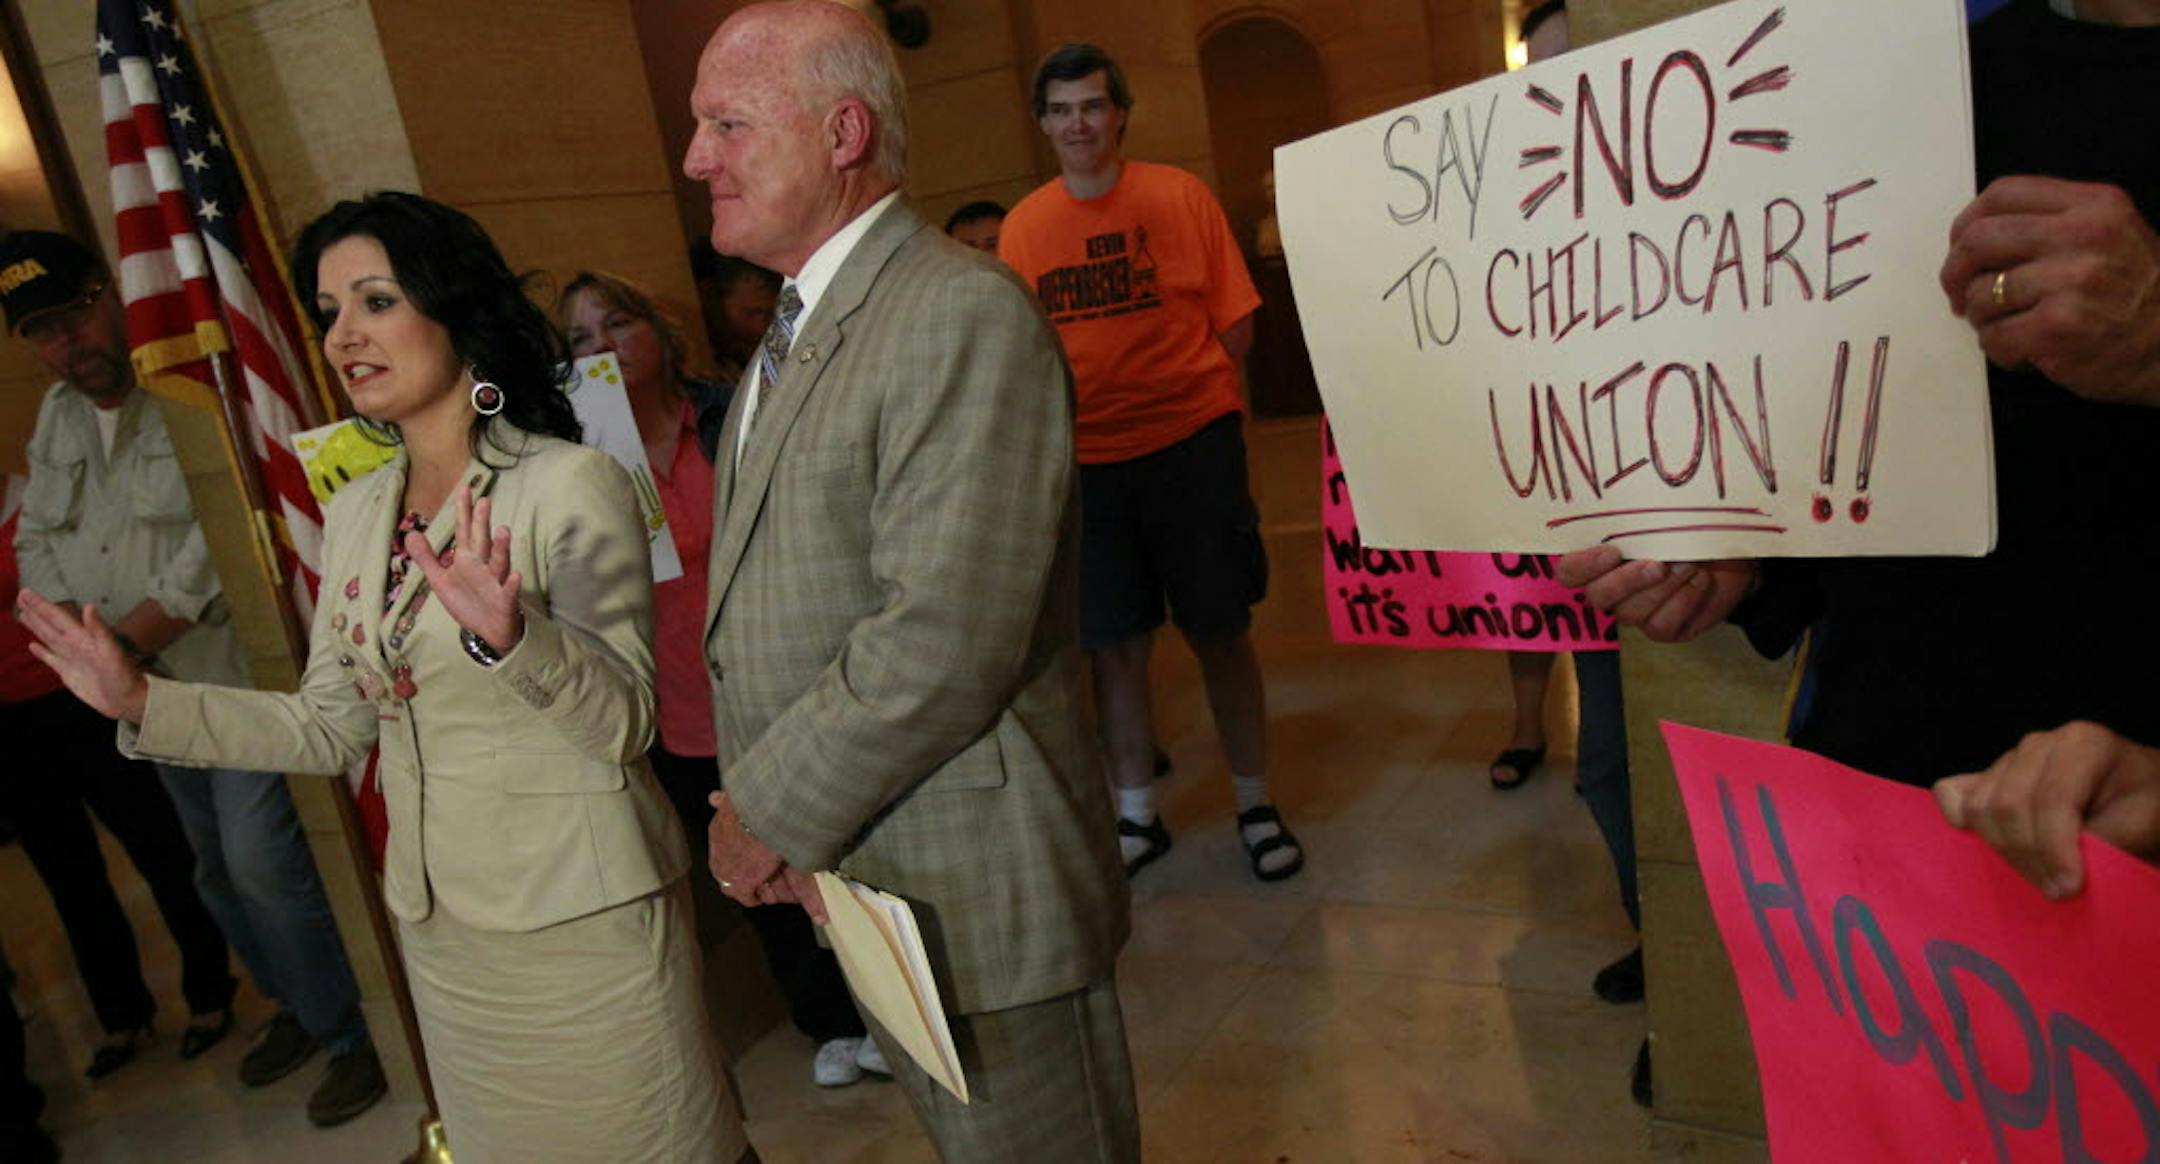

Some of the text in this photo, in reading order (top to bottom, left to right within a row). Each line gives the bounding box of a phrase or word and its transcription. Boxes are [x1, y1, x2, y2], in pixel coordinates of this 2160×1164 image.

[1383, 49, 1716, 240] SAY NO
[1382, 177, 1878, 350] TO CHILDCARE
[1488, 354, 1778, 504] UNION
[1338, 582, 1410, 637] it's
